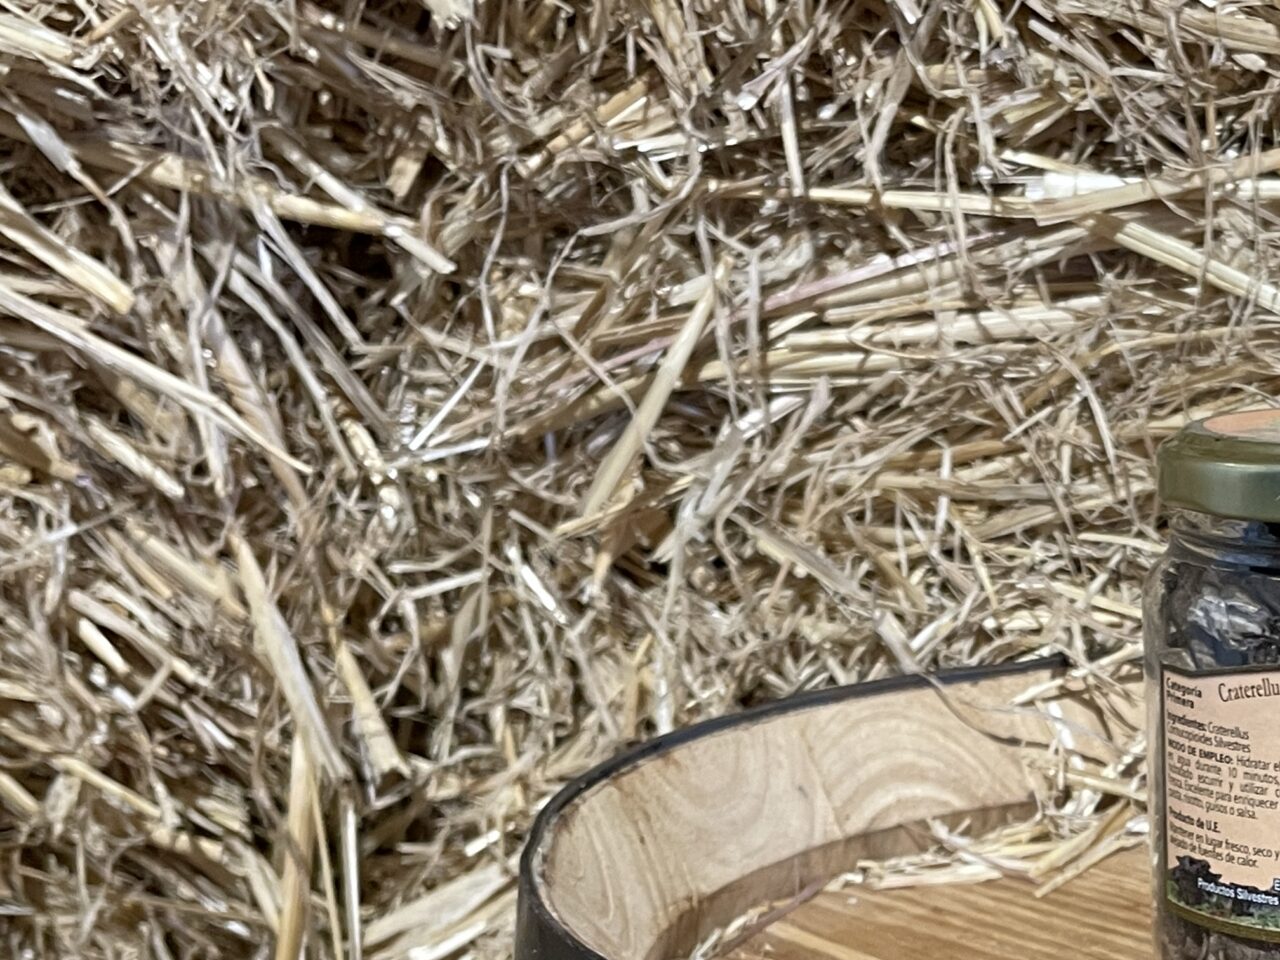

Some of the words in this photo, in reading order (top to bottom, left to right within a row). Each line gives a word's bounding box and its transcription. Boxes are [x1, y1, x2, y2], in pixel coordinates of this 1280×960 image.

[1187, 745, 1196, 756] DE
[1199, 748, 1233, 765] EMPLEO:
[1236, 755, 1271, 770] Hidratar
[1273, 761, 1280, 771] el
[1195, 760, 1222, 775] durante
[1228, 766, 1237, 778] 10
[1240, 783, 1268, 796] utilizar
[1205, 800, 1228, 815] guisos
[1229, 806, 1235, 815] o
[1215, 790, 1232, 802] para
[1233, 793, 1279, 812] enriquecer
[1205, 822, 1221, 833] U.E.
[1205, 833, 1223, 849] lugar
[1224, 839, 1250, 856] fresco,
[1252, 845, 1272, 858] seco
[1274, 850, 1280, 861] y
[1225, 851, 1235, 863] de
[1198, 878, 1235, 898] Productos
[1236, 888, 1279, 906] Silvestres
